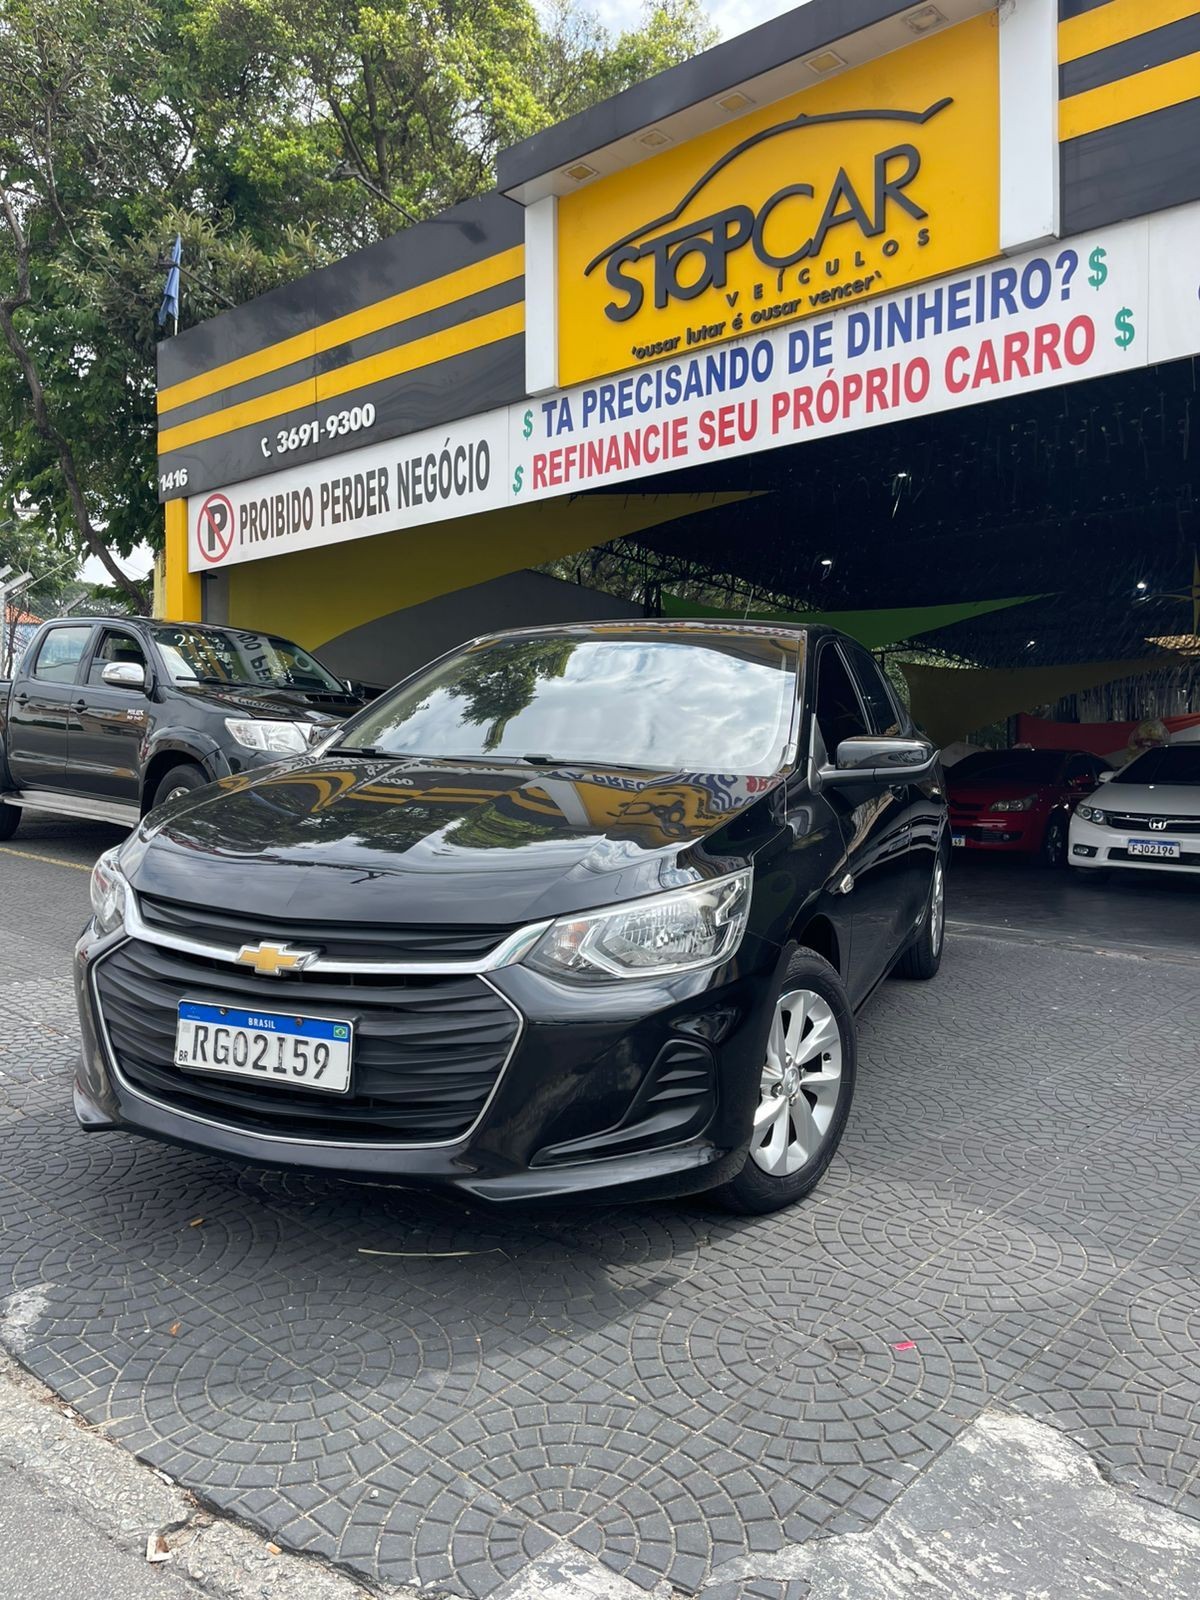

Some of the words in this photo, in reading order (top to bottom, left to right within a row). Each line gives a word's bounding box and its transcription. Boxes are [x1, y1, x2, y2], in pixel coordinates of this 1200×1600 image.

[604, 143, 929, 323] STOPCAR
[726, 228, 930, 308] VEÍCULOS
[523, 409, 534, 441] $
[542, 399, 573, 435] TA
[582, 330, 774, 428] PRECISANDO
[788, 322, 833, 374] DE
[847, 249, 1080, 358] DINHEIRO?
[1088, 246, 1108, 291] $
[686, 321, 727, 346] lutar
[731, 312, 744, 331] é
[750, 298, 802, 325] ousar
[276, 402, 376, 454] 3691-9300
[512, 464, 524, 496] $
[533, 417, 688, 489] REFINANCIE
[698, 399, 758, 451] SEU
[772, 356, 930, 435] PRÓPRIO
[944, 315, 1095, 394] CARRO
[1114, 307, 1135, 351] $
[160, 468, 188, 492] 1416
[240, 486, 313, 545] PROIBIDO
[320, 466, 390, 530] PERDER
[397, 437, 490, 510] NEGÓCIO
[178, 1050, 188, 1063] BR
[247, 1017, 276, 1030] BRASIL
